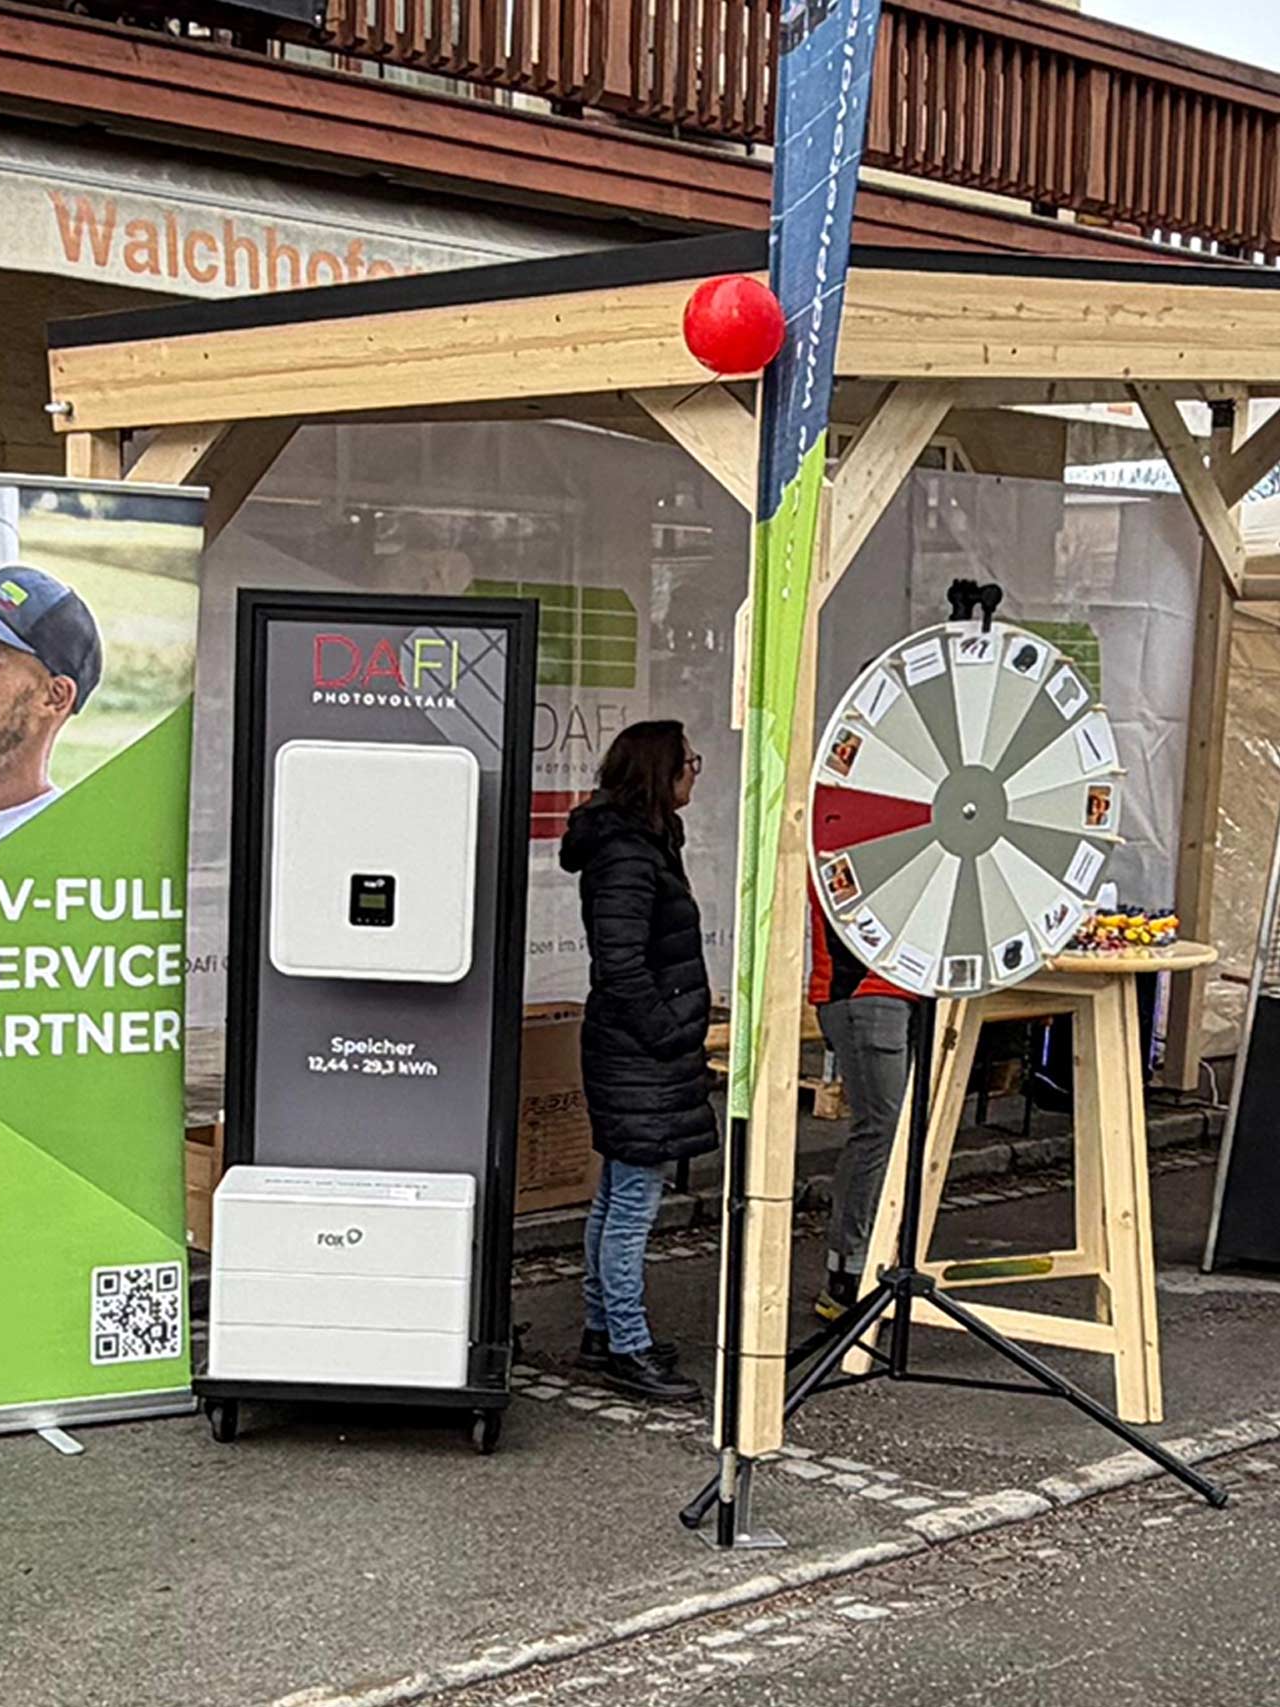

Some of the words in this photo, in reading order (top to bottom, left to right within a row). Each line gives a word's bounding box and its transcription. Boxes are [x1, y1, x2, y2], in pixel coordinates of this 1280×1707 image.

[313, 633, 460, 691] DAFI
[331, 1036, 416, 1057] Speicher
[398, 1061, 438, 1076] kWh
